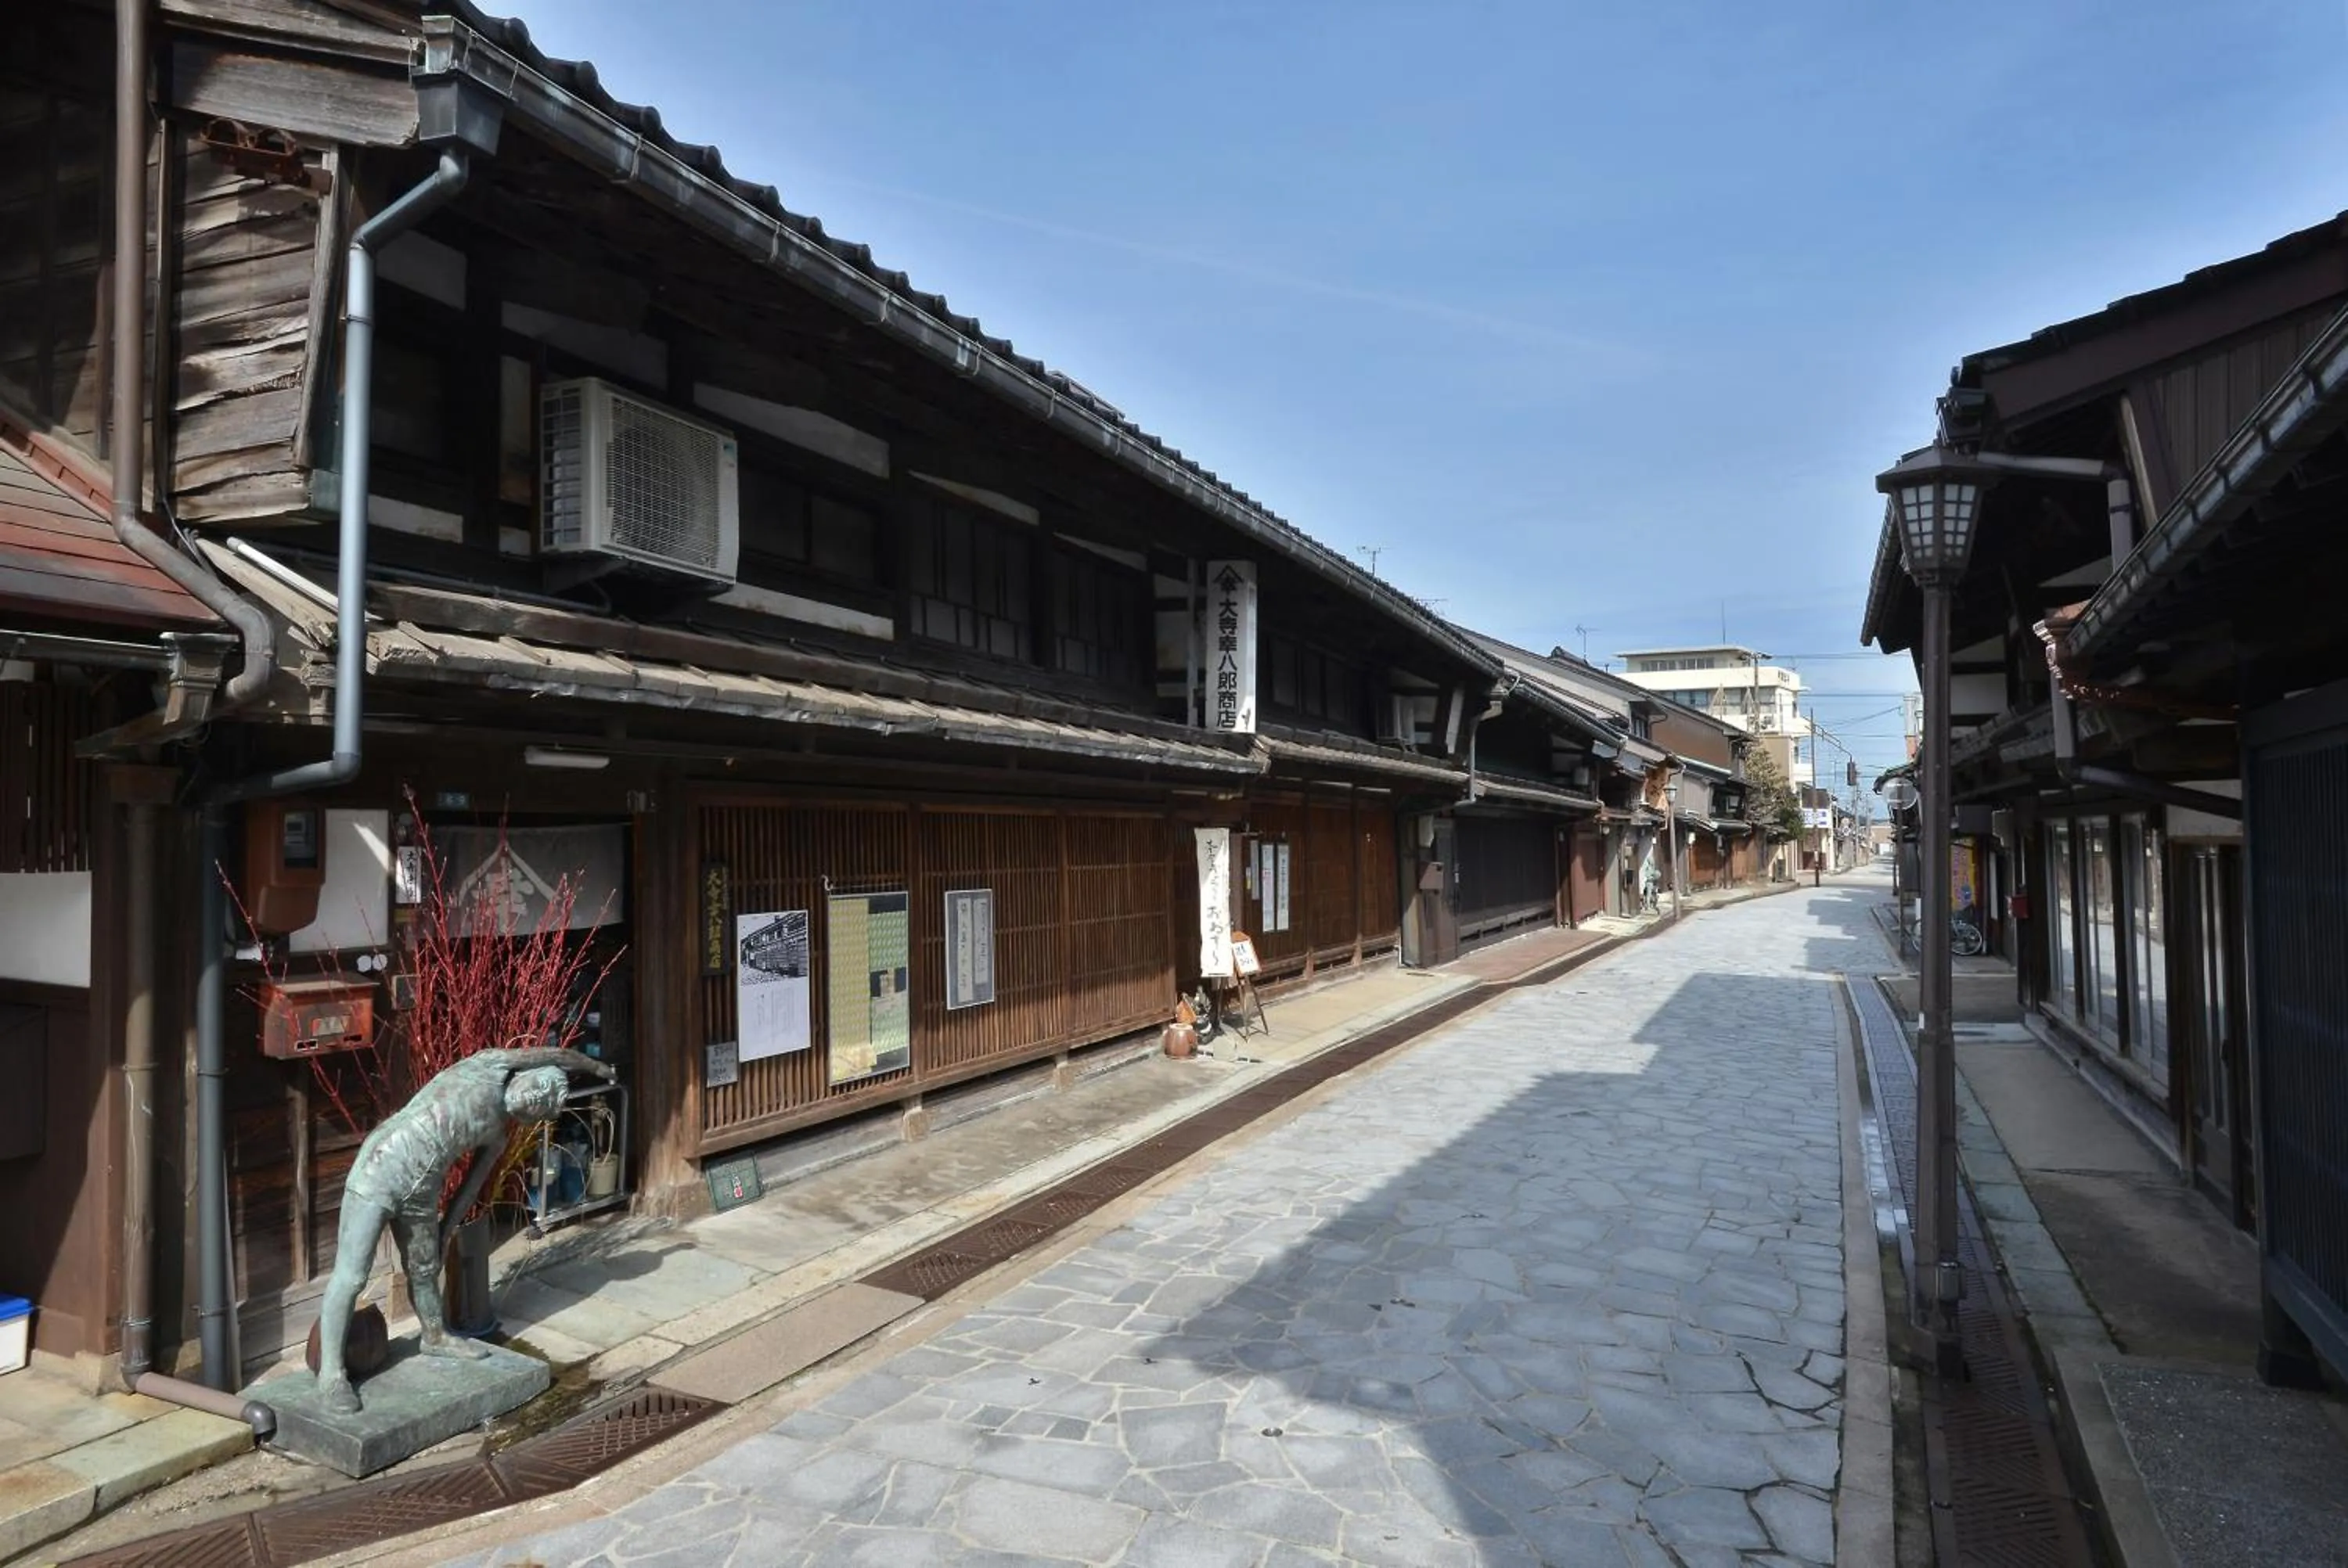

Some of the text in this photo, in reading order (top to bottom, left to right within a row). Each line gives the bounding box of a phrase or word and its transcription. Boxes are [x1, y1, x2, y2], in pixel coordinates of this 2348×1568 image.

[1217, 599, 1238, 728] 大寺幸八郎商店
